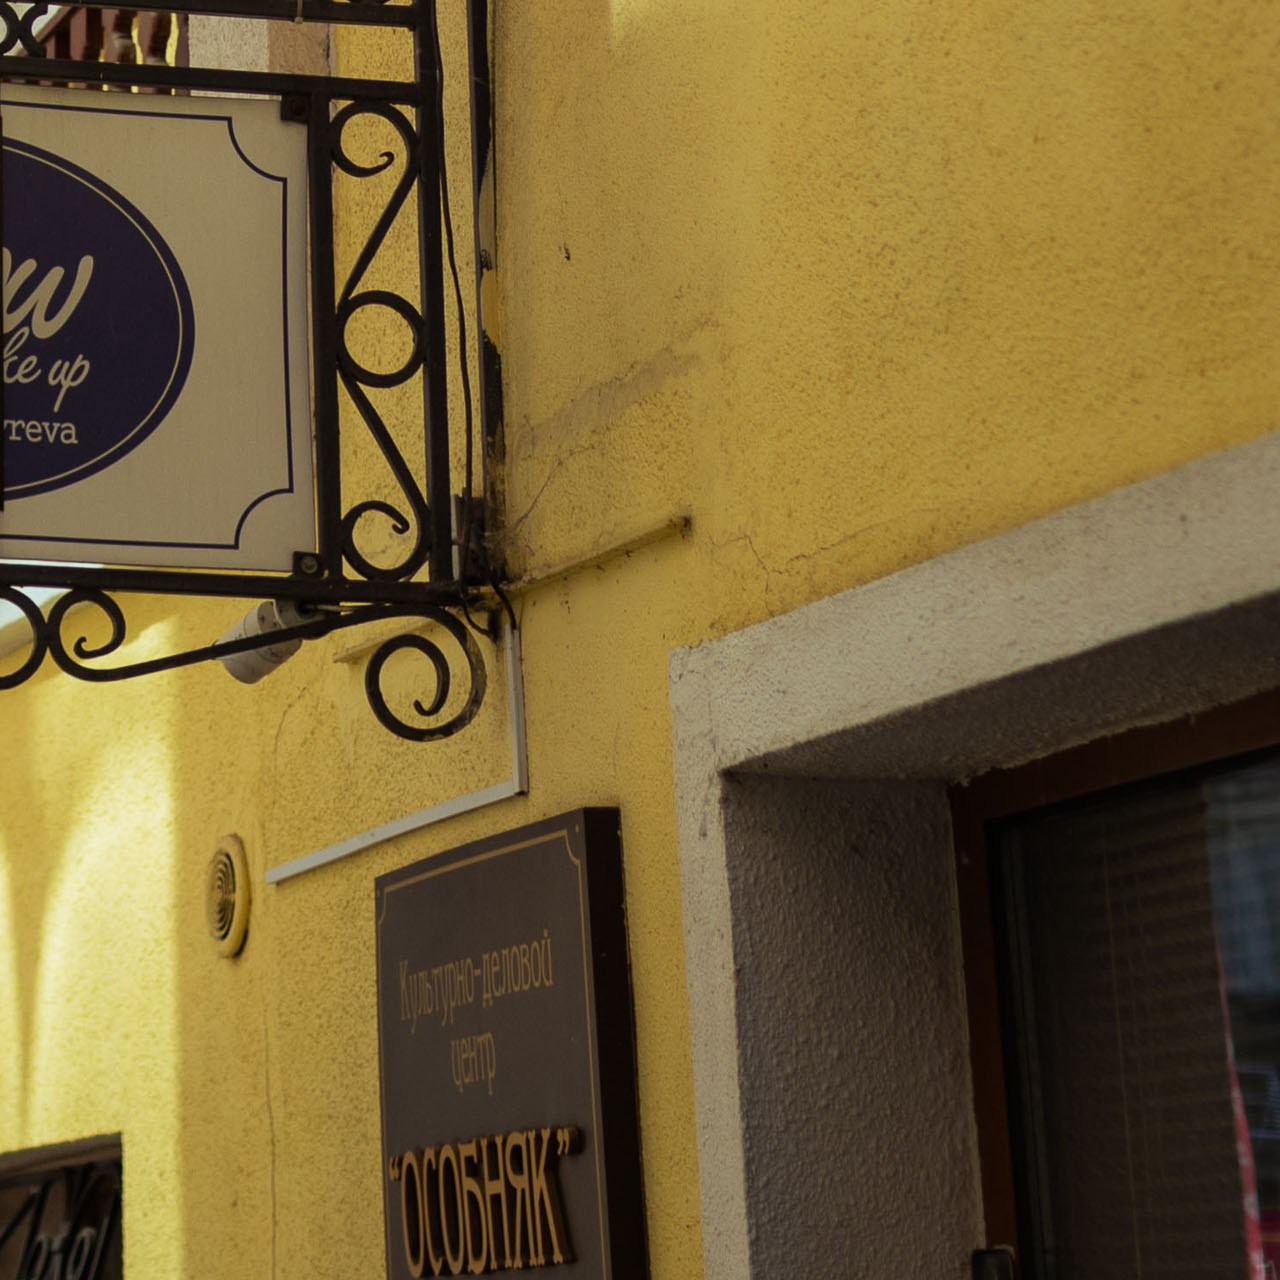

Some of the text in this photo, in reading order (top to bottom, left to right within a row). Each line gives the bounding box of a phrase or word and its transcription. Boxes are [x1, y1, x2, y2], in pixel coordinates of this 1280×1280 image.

[48, 353, 90, 413] up
[399, 927, 554, 1034] Культурно-деловой
[451, 1031, 497, 1096] центр
